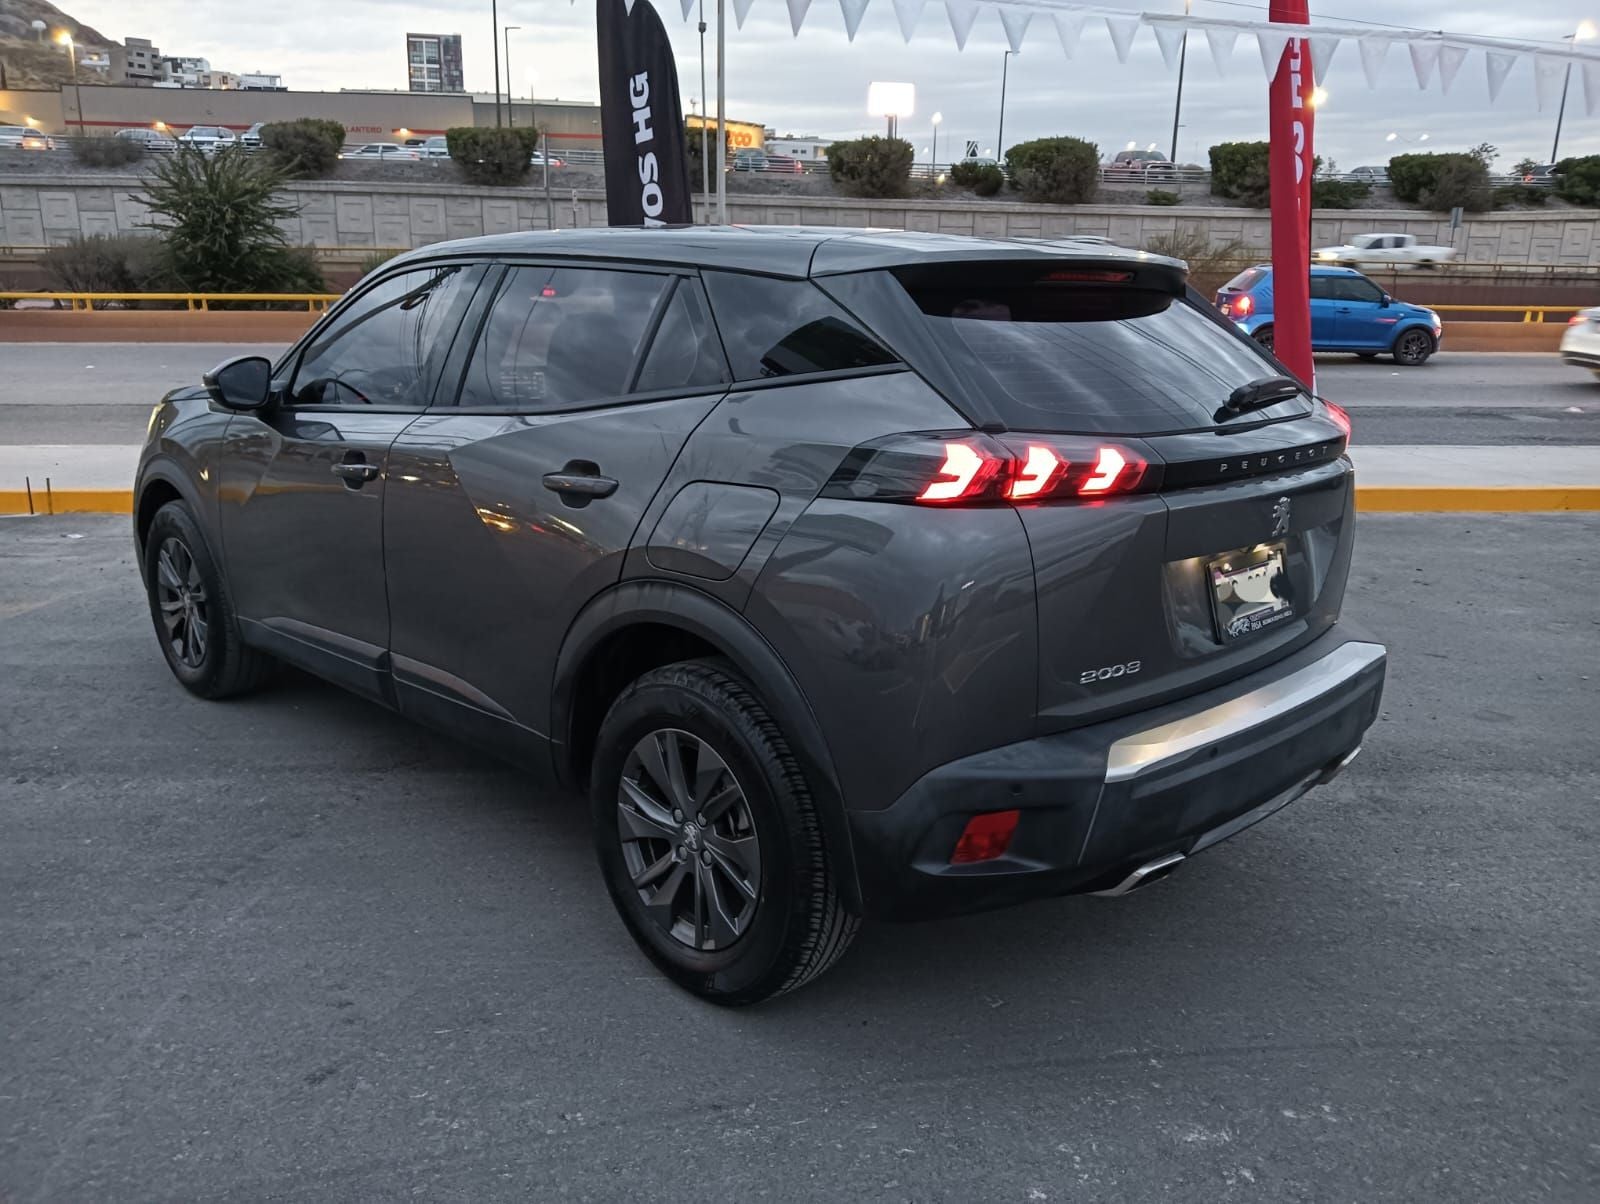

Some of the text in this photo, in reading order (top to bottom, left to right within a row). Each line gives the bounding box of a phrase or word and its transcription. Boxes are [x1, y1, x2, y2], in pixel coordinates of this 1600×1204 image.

[629, 71, 654, 145] HG
[1219, 445, 1328, 472] PEUGEOT
[1080, 660, 1141, 685] 2008
